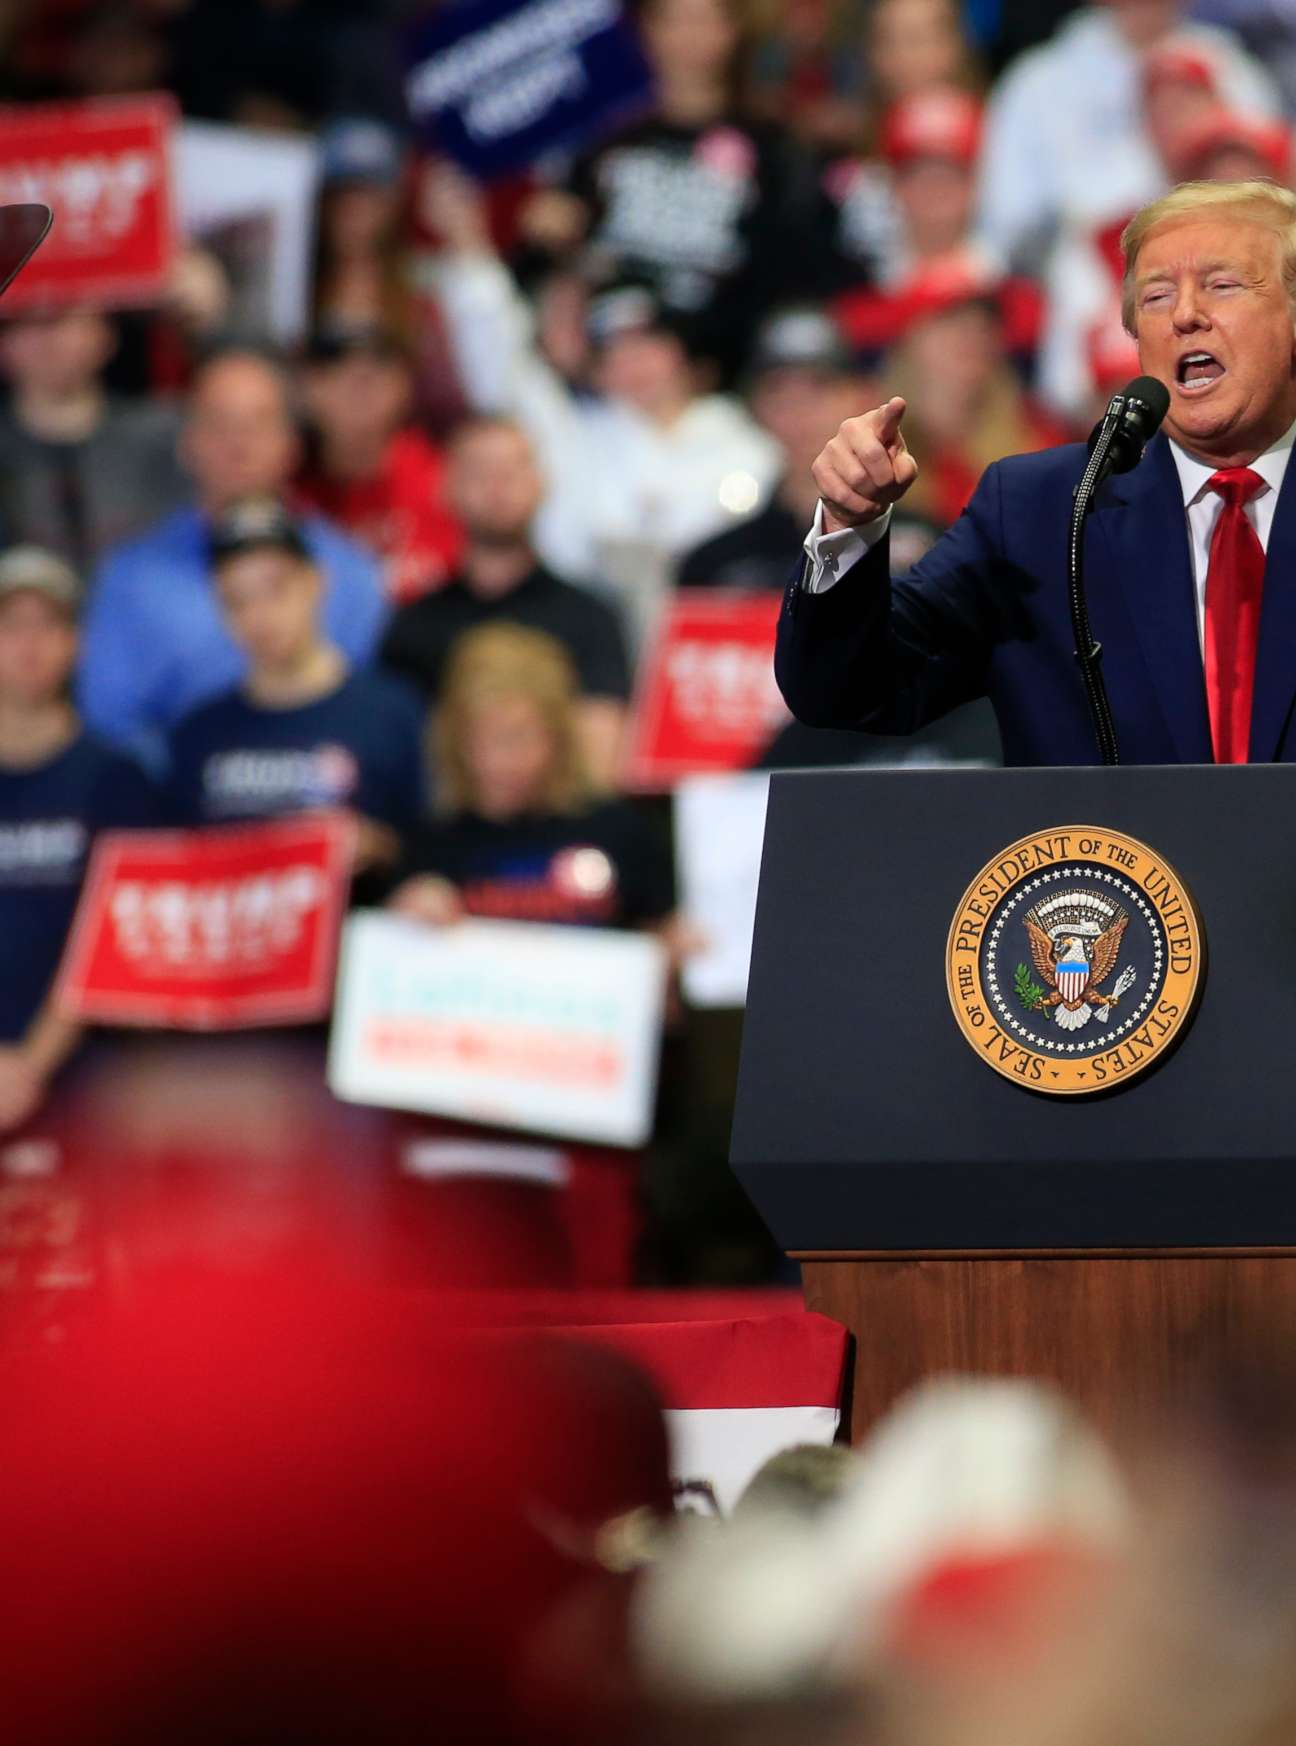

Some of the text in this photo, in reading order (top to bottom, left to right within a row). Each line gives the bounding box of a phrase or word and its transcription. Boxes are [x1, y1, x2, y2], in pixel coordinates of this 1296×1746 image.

[956, 836, 1191, 1080] SEAL OF THE PRESIDENT OF THE UNITED STATES
